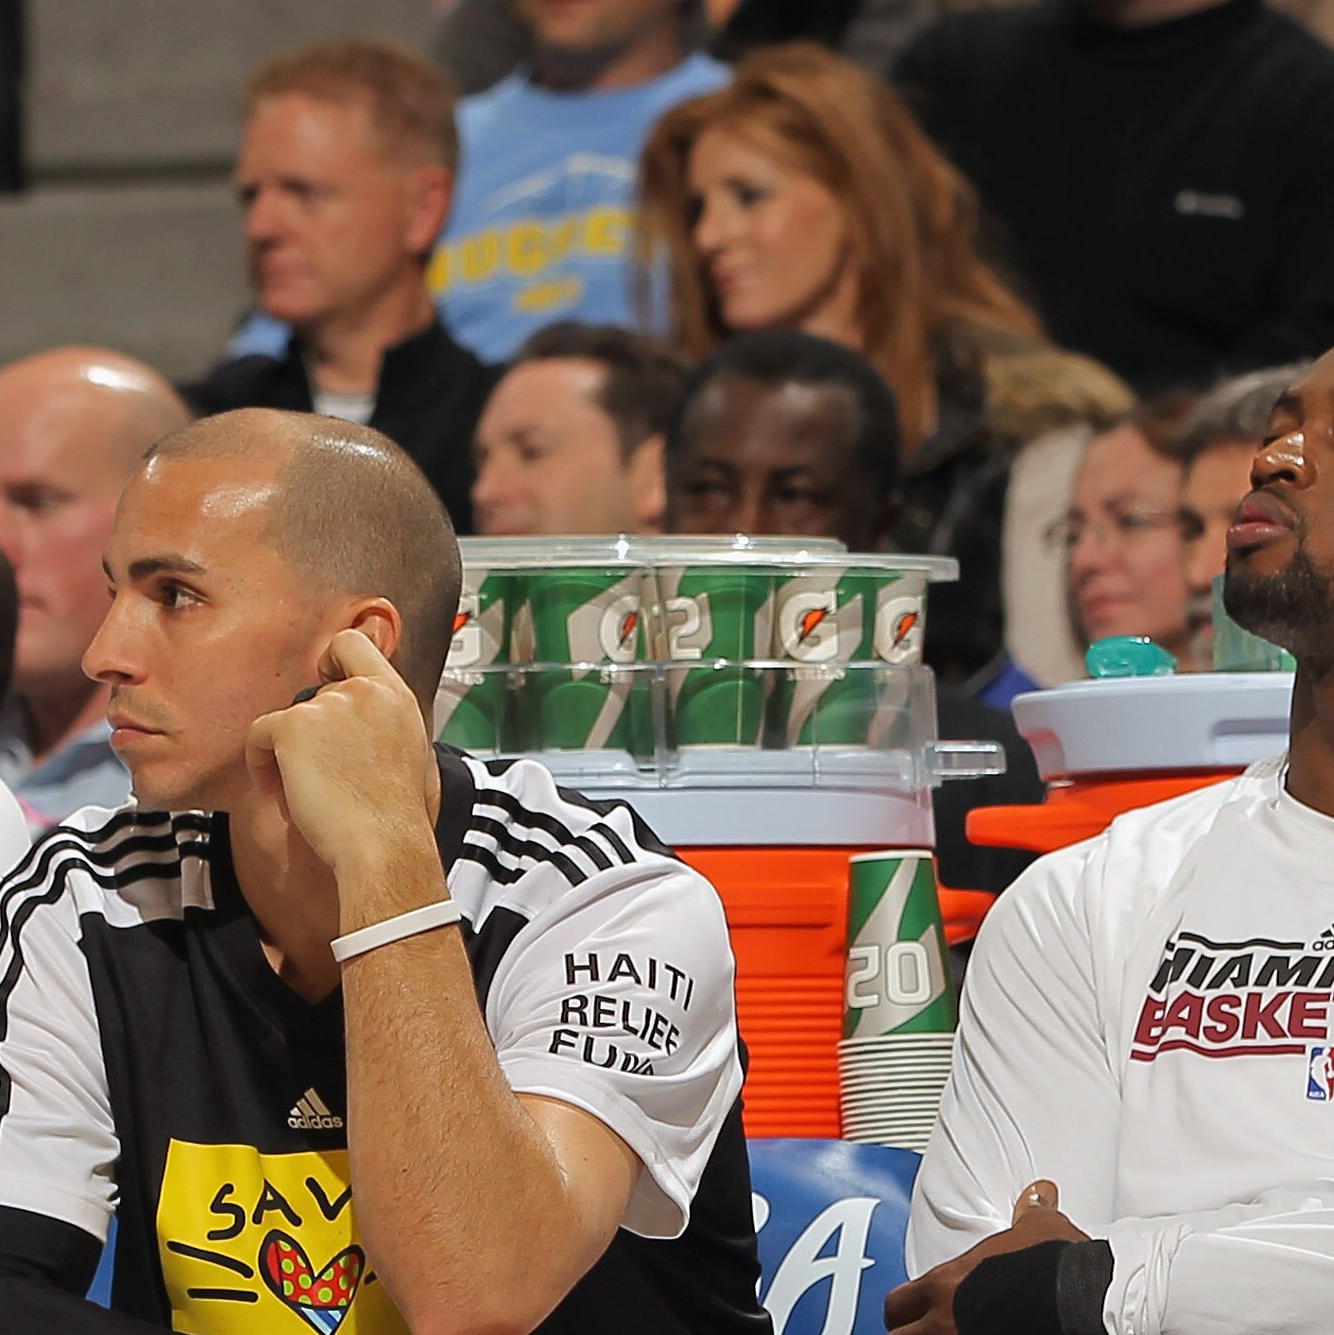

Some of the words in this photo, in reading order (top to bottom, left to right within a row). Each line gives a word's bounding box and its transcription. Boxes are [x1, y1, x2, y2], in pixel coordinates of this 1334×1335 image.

[779, 590, 839, 663] G
[564, 952, 695, 1012] HAITI
[847, 941, 932, 1009] 20
[560, 994, 680, 1057] RELIEF
[287, 1114, 344, 1130] adidas
